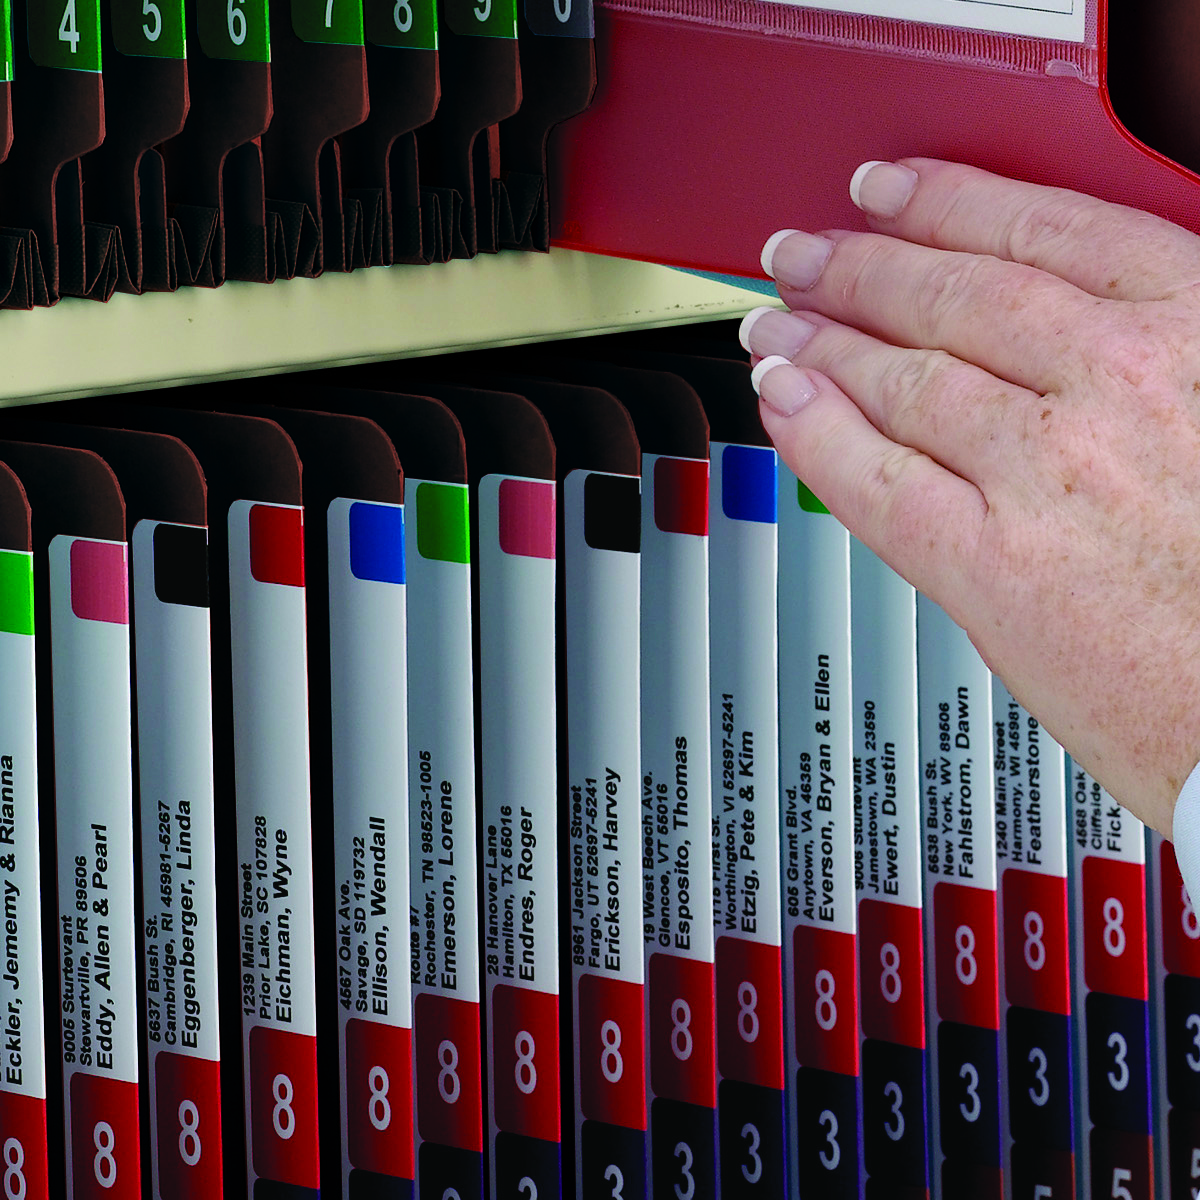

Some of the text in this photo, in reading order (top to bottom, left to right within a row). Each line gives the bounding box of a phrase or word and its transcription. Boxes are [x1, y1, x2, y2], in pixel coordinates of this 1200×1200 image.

[602, 767, 622, 972] Erickson, Harvey
[672, 736, 694, 951] Esposito, Thomas
[738, 731, 760, 934] Etzig, Pete & Kim
[814, 654, 836, 923] Everson, Bryan & Ellen
[880, 742, 899, 896] Ewert, Dustin
[955, 686, 974, 879] Fahlstrom, Dawn
[0, 755, 23, 1086] Eckler, Jememy & Rianna
[90, 823, 116, 1070] Eddy, Allen & Pearl
[174, 800, 201, 1049] Eggenberger, Linda
[272, 828, 293, 1024] Eichman, Wyne
[369, 816, 390, 1016] Ellison, Wendall
[437, 780, 457, 991] Emerson, Lorene
[517, 806, 537, 982] Endres, Roger
